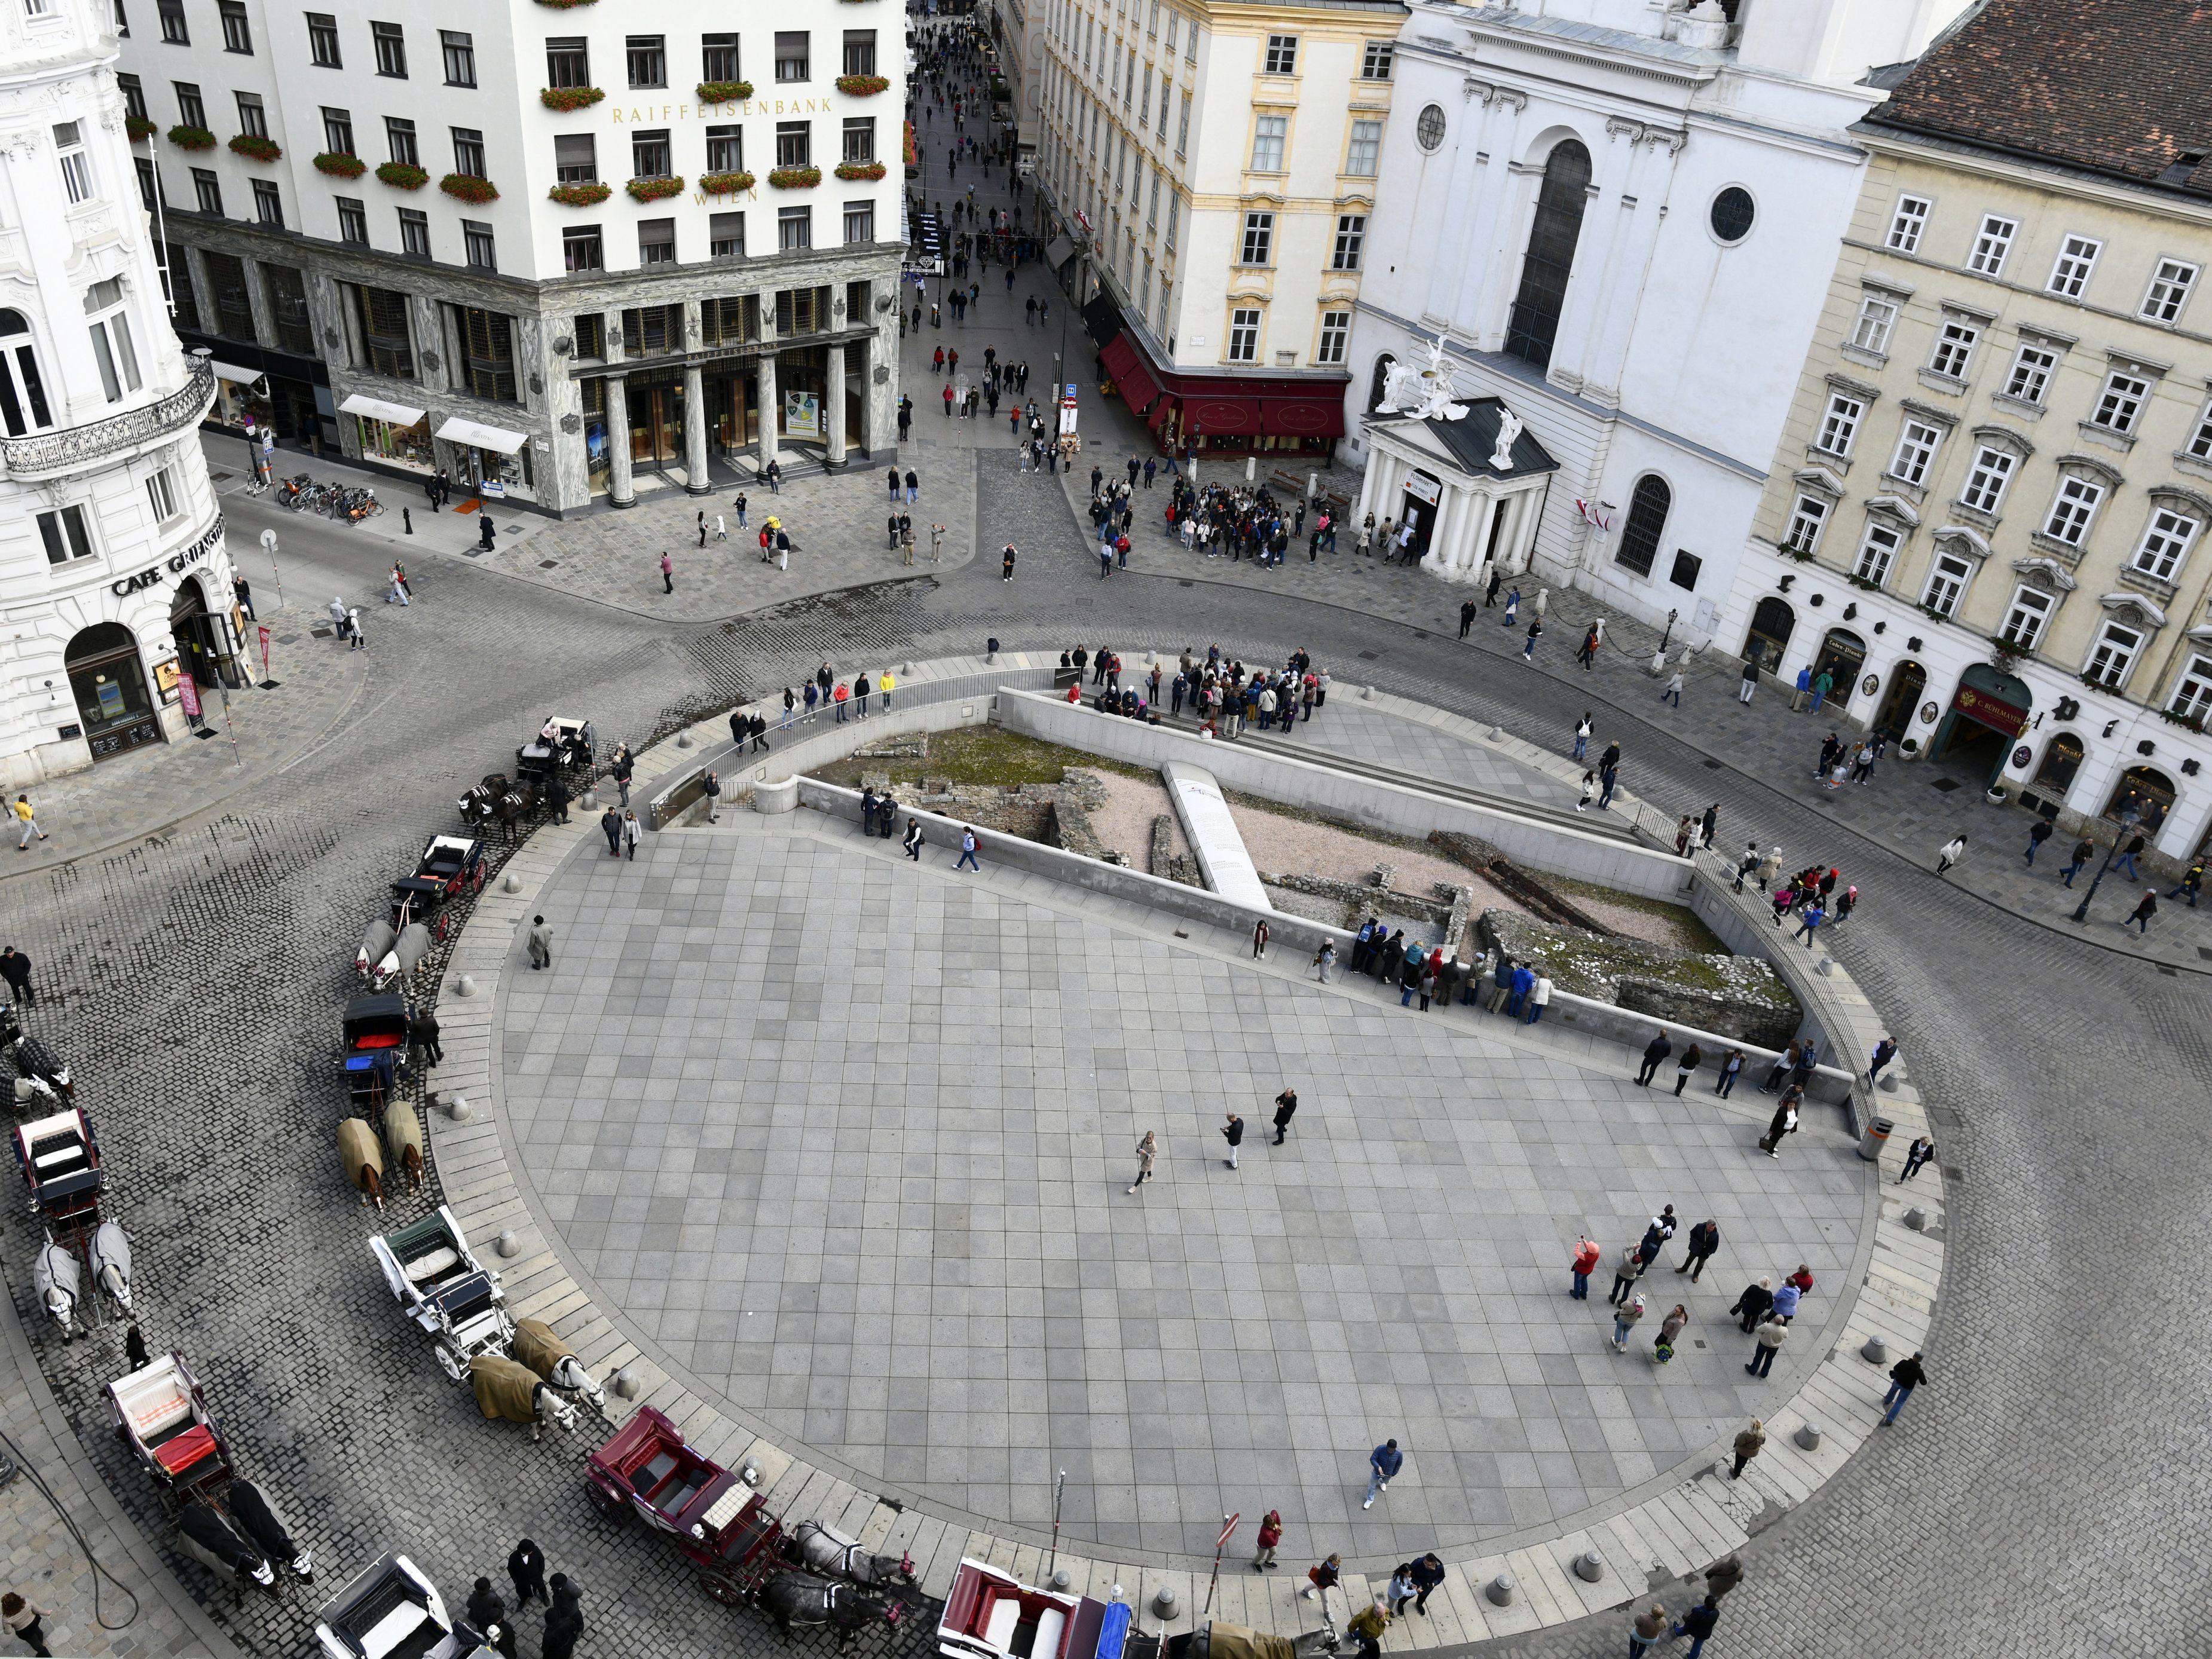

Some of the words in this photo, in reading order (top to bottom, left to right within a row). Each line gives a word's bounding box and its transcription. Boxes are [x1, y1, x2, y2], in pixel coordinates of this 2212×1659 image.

[613, 97, 831, 123] RAIFFEISENBANK
[693, 189, 758, 207] WIEN
[687, 343, 778, 362] RAIFFEISENBANK
[1411, 472, 1433, 489] FLOHMARKT
[1418, 486, 1428, 496] MARKET
[168, 512, 227, 573] GRIENSTEID
[1984, 703, 2022, 725] BÜHLMAYER
